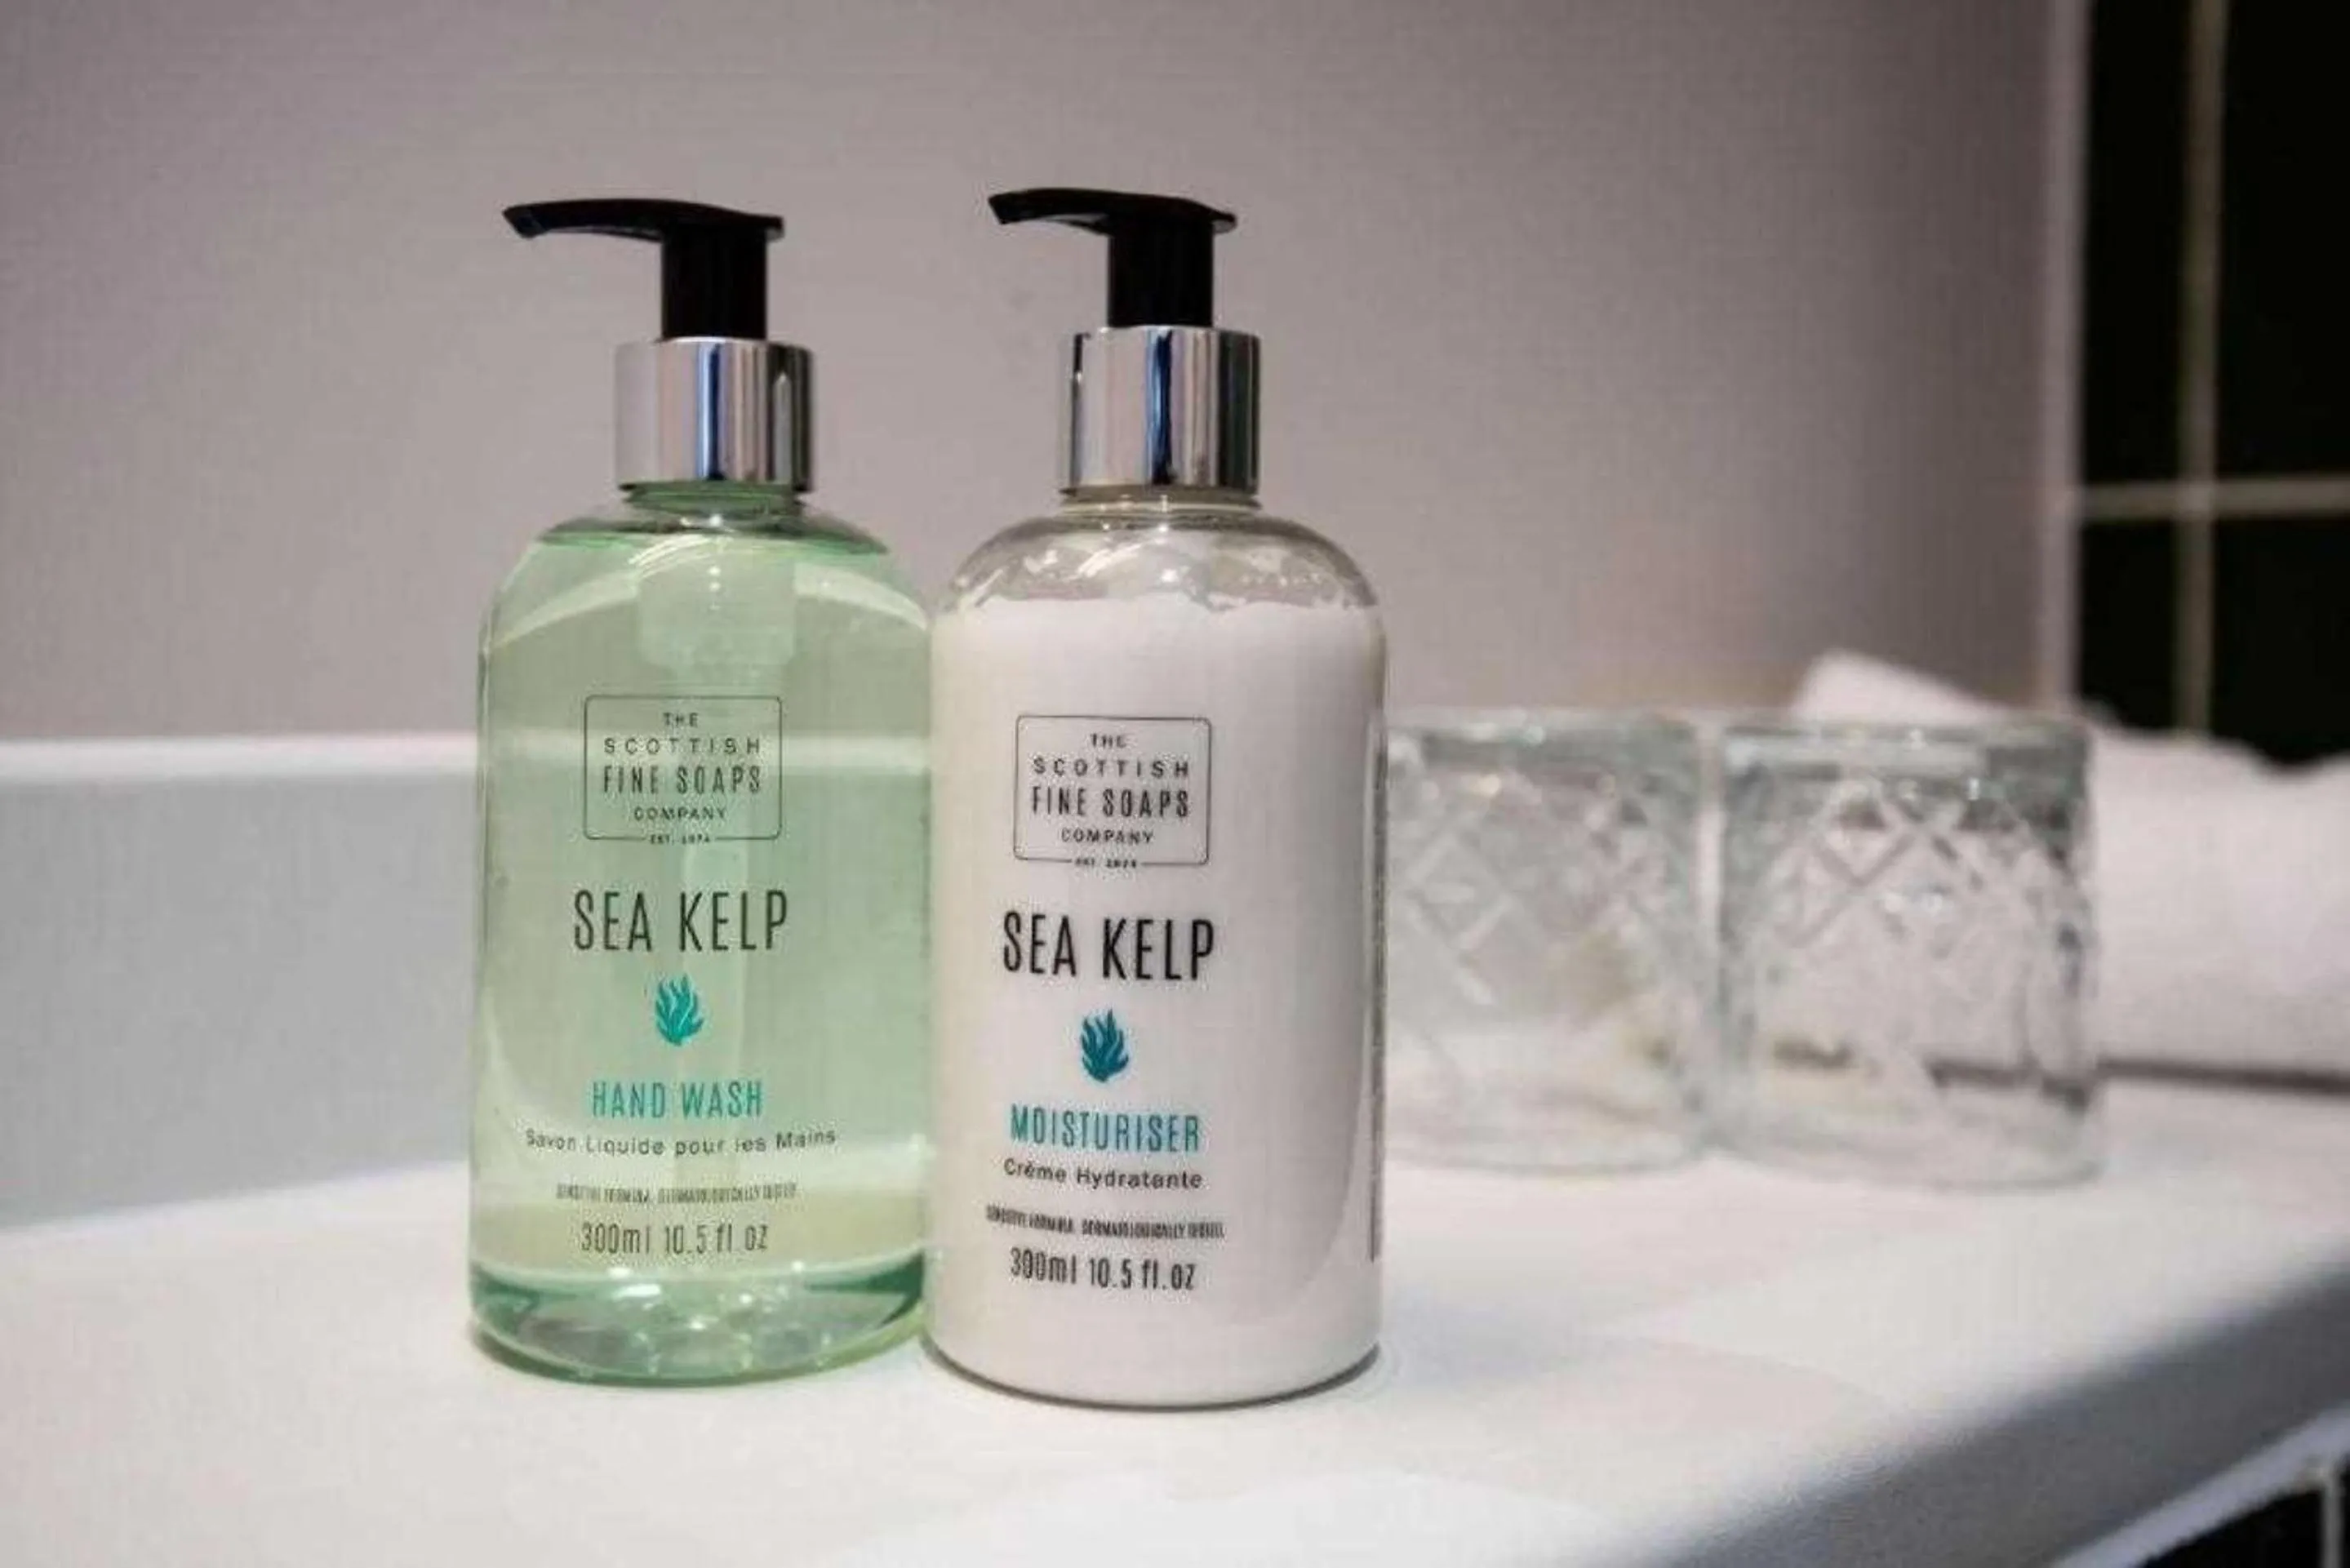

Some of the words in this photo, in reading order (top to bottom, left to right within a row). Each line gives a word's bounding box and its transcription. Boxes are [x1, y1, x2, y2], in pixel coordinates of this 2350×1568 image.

[662, 712, 699, 728] THE
[604, 737, 760, 757] SCOTTISH
[1090, 732, 1126, 749] THE
[603, 765, 658, 795] FINE
[675, 762, 762, 796] SOAPS
[1033, 755, 1189, 780] SCOTTISH
[633, 806, 726, 823] COMPANY
[1032, 785, 1086, 817] FINE
[1102, 788, 1189, 820] SOAPS
[1061, 828, 1153, 846] COMPANY
[574, 889, 653, 953] SEA
[678, 889, 788, 953] KELP
[1002, 909, 1077, 978] SEA
[1102, 917, 1215, 982] KELP
[592, 1081, 666, 1119] HAND
[681, 1080, 763, 1118] WASH
[525, 1128, 576, 1151] Savon
[585, 1135, 665, 1157] Liquide
[674, 1139, 725, 1158] pour
[775, 1130, 836, 1150] Mains
[1011, 1104, 1200, 1153] MOISTURISER
[1076, 1166, 1203, 1190] Hydratante
[581, 1221, 651, 1255] 300ml
[664, 1224, 707, 1256] 10.5
[1010, 1246, 1077, 1285] 300ml
[1088, 1257, 1133, 1290] 10.5
